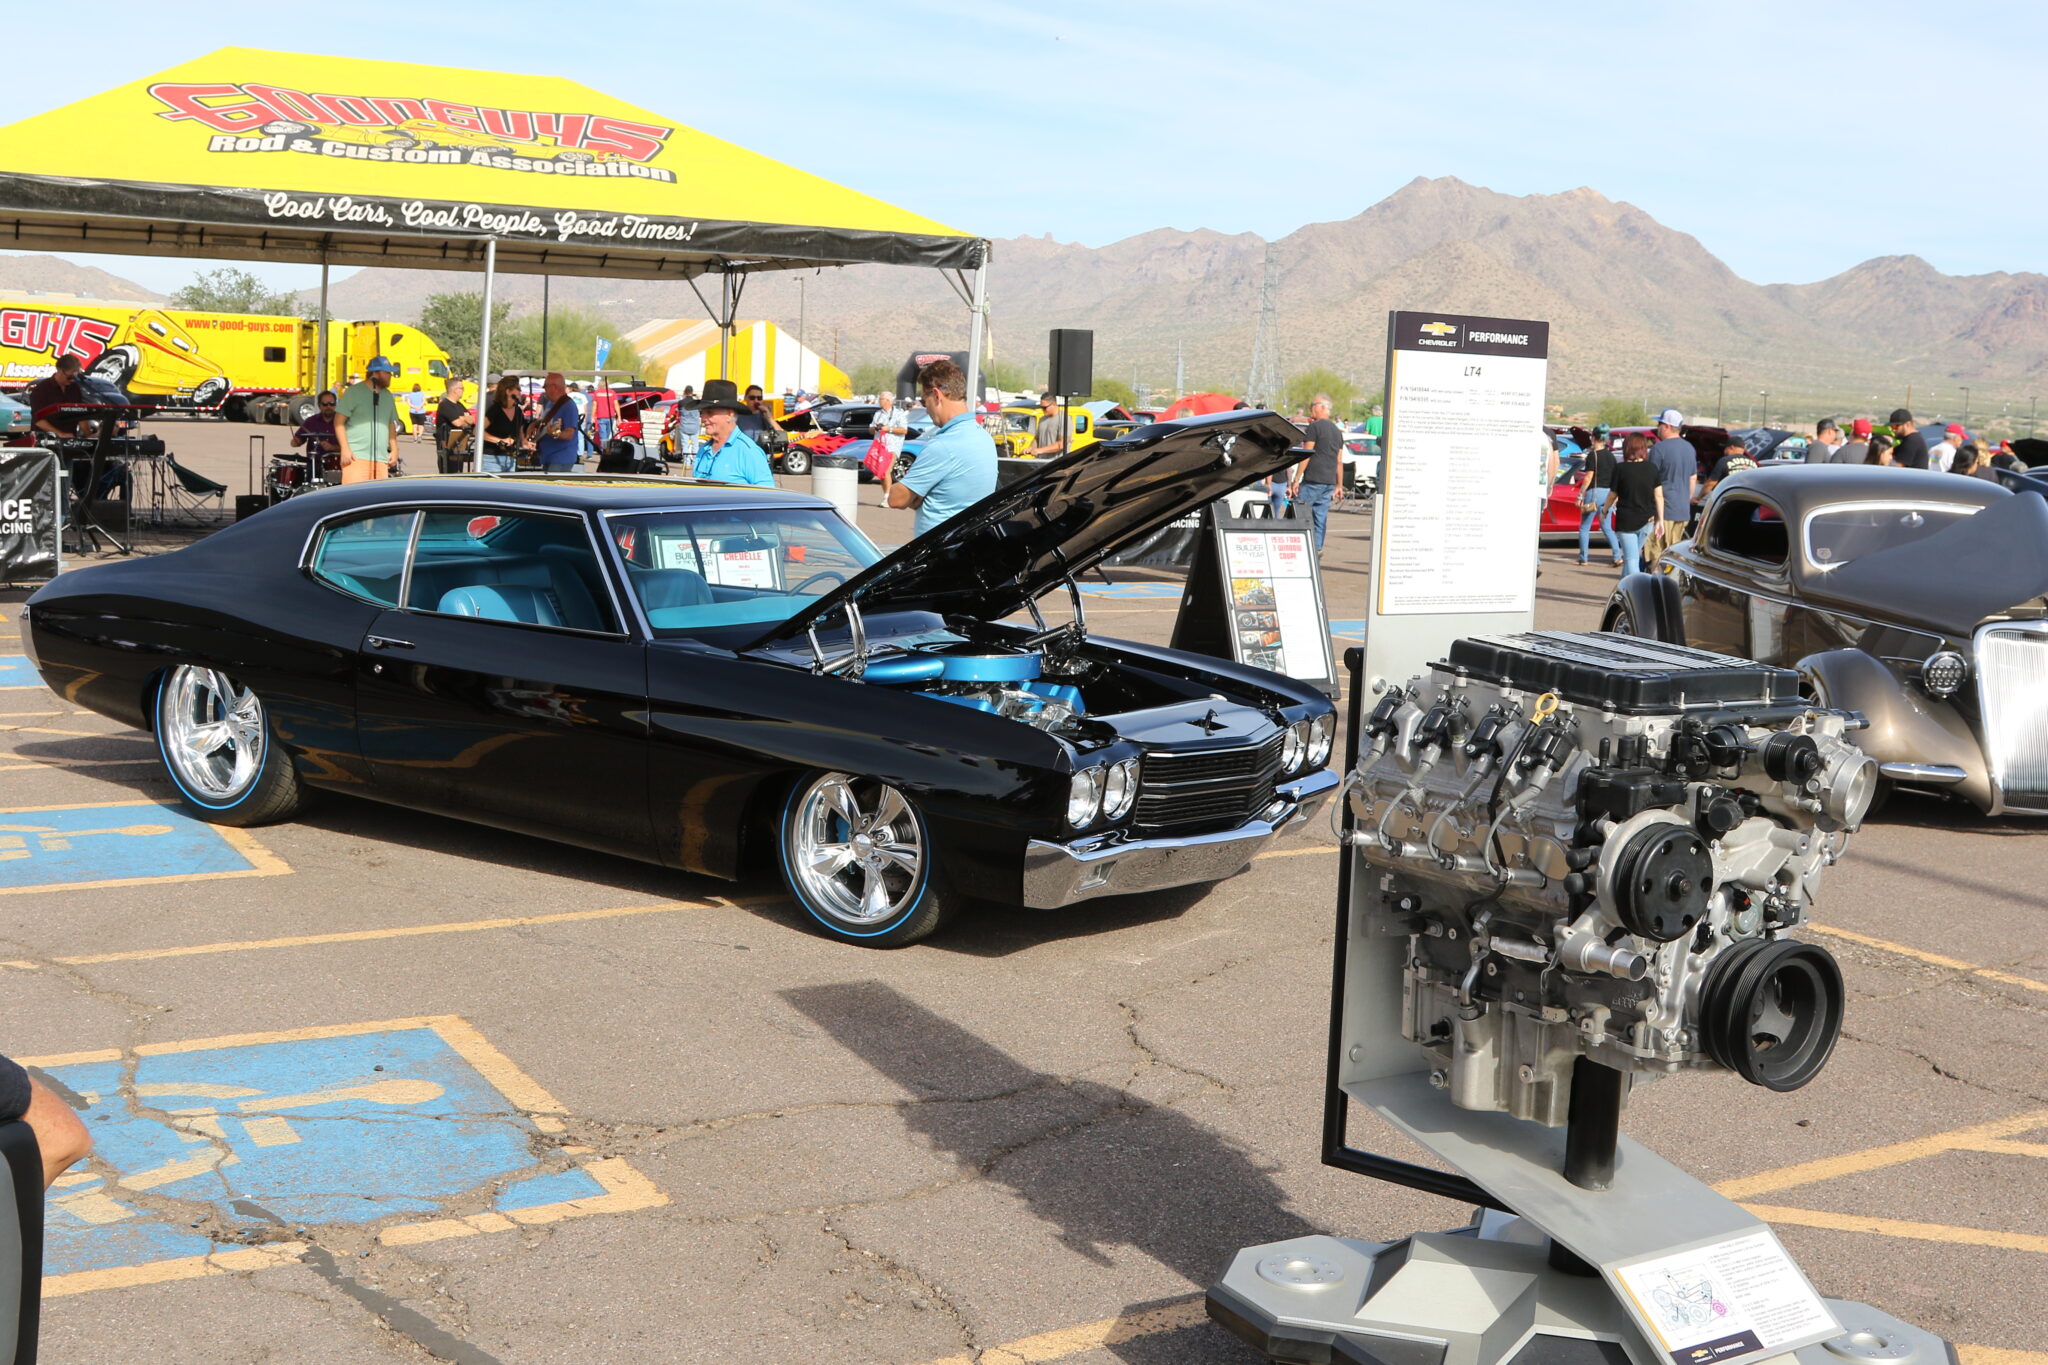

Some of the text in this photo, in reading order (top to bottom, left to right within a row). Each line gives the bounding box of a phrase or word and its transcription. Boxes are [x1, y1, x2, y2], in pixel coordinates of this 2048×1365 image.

[208, 135, 672, 182] Rod & Custom Association
[264, 192, 698, 242] Cool Cars, Cool People, Good Times!
[1, 311, 116, 370] GUYS
[1418, 338, 1457, 348] CHEVROLET
[1469, 331, 1529, 346] PERFORMANCE
[1464, 366, 1482, 377] LT4
[0, 499, 33, 520] CE
[0, 522, 33, 535] CING
[675, 552, 712, 561] BUILER
